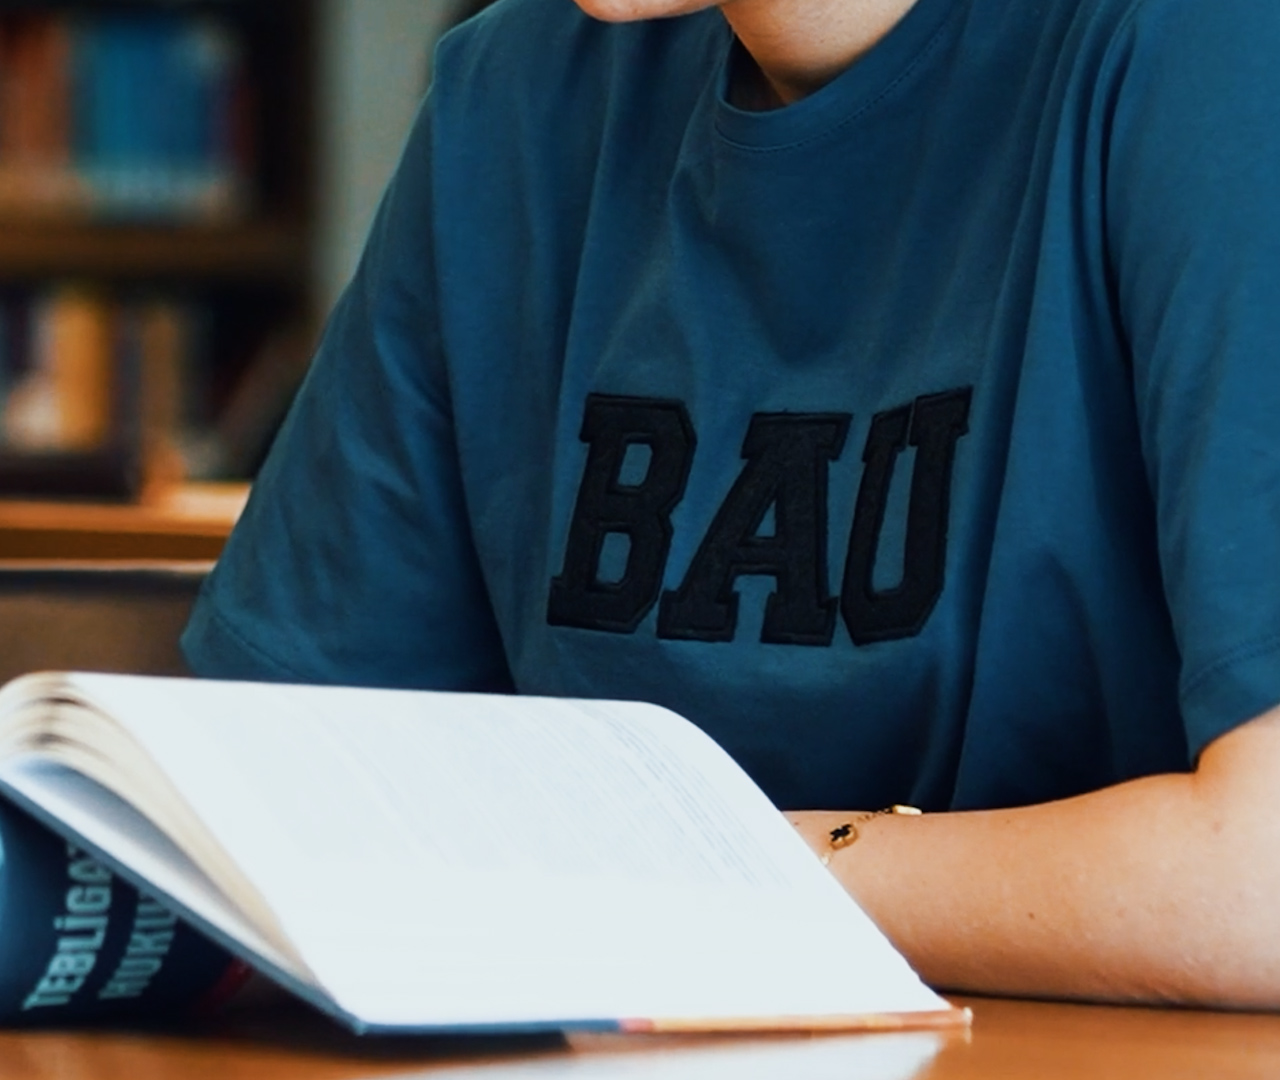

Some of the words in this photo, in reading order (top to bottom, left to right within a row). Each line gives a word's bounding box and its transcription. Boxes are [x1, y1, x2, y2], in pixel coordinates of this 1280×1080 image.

[547, 386, 974, 646] BAU
[24, 841, 113, 1008] TEBLİGA
[99, 894, 175, 999] HUKU
